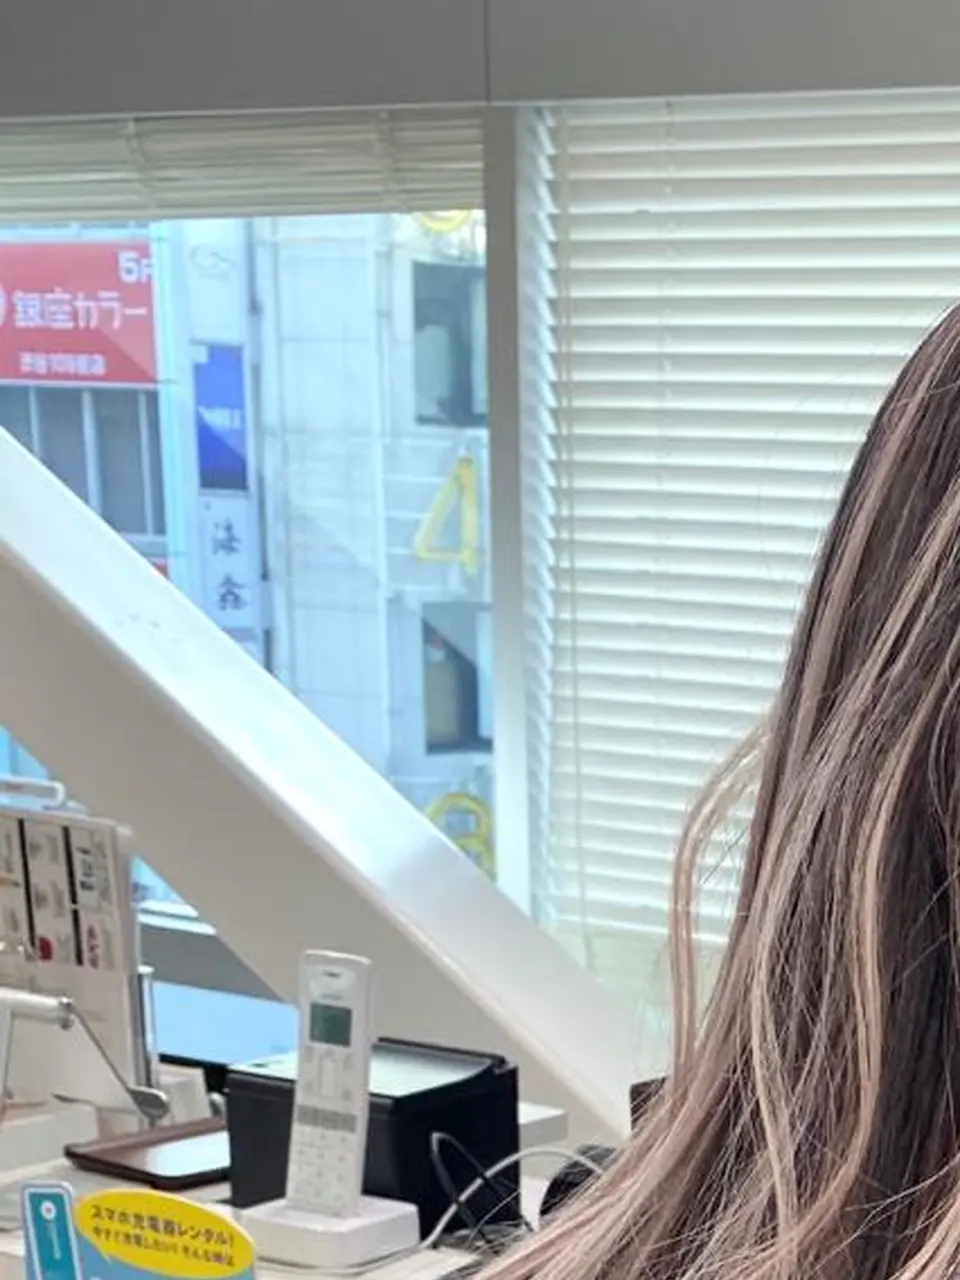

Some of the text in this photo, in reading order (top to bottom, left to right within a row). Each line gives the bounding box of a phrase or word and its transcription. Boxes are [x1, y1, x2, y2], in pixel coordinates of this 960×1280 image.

[14, 285, 147, 330] 銀座カラー
[414, 458, 478, 577] 4
